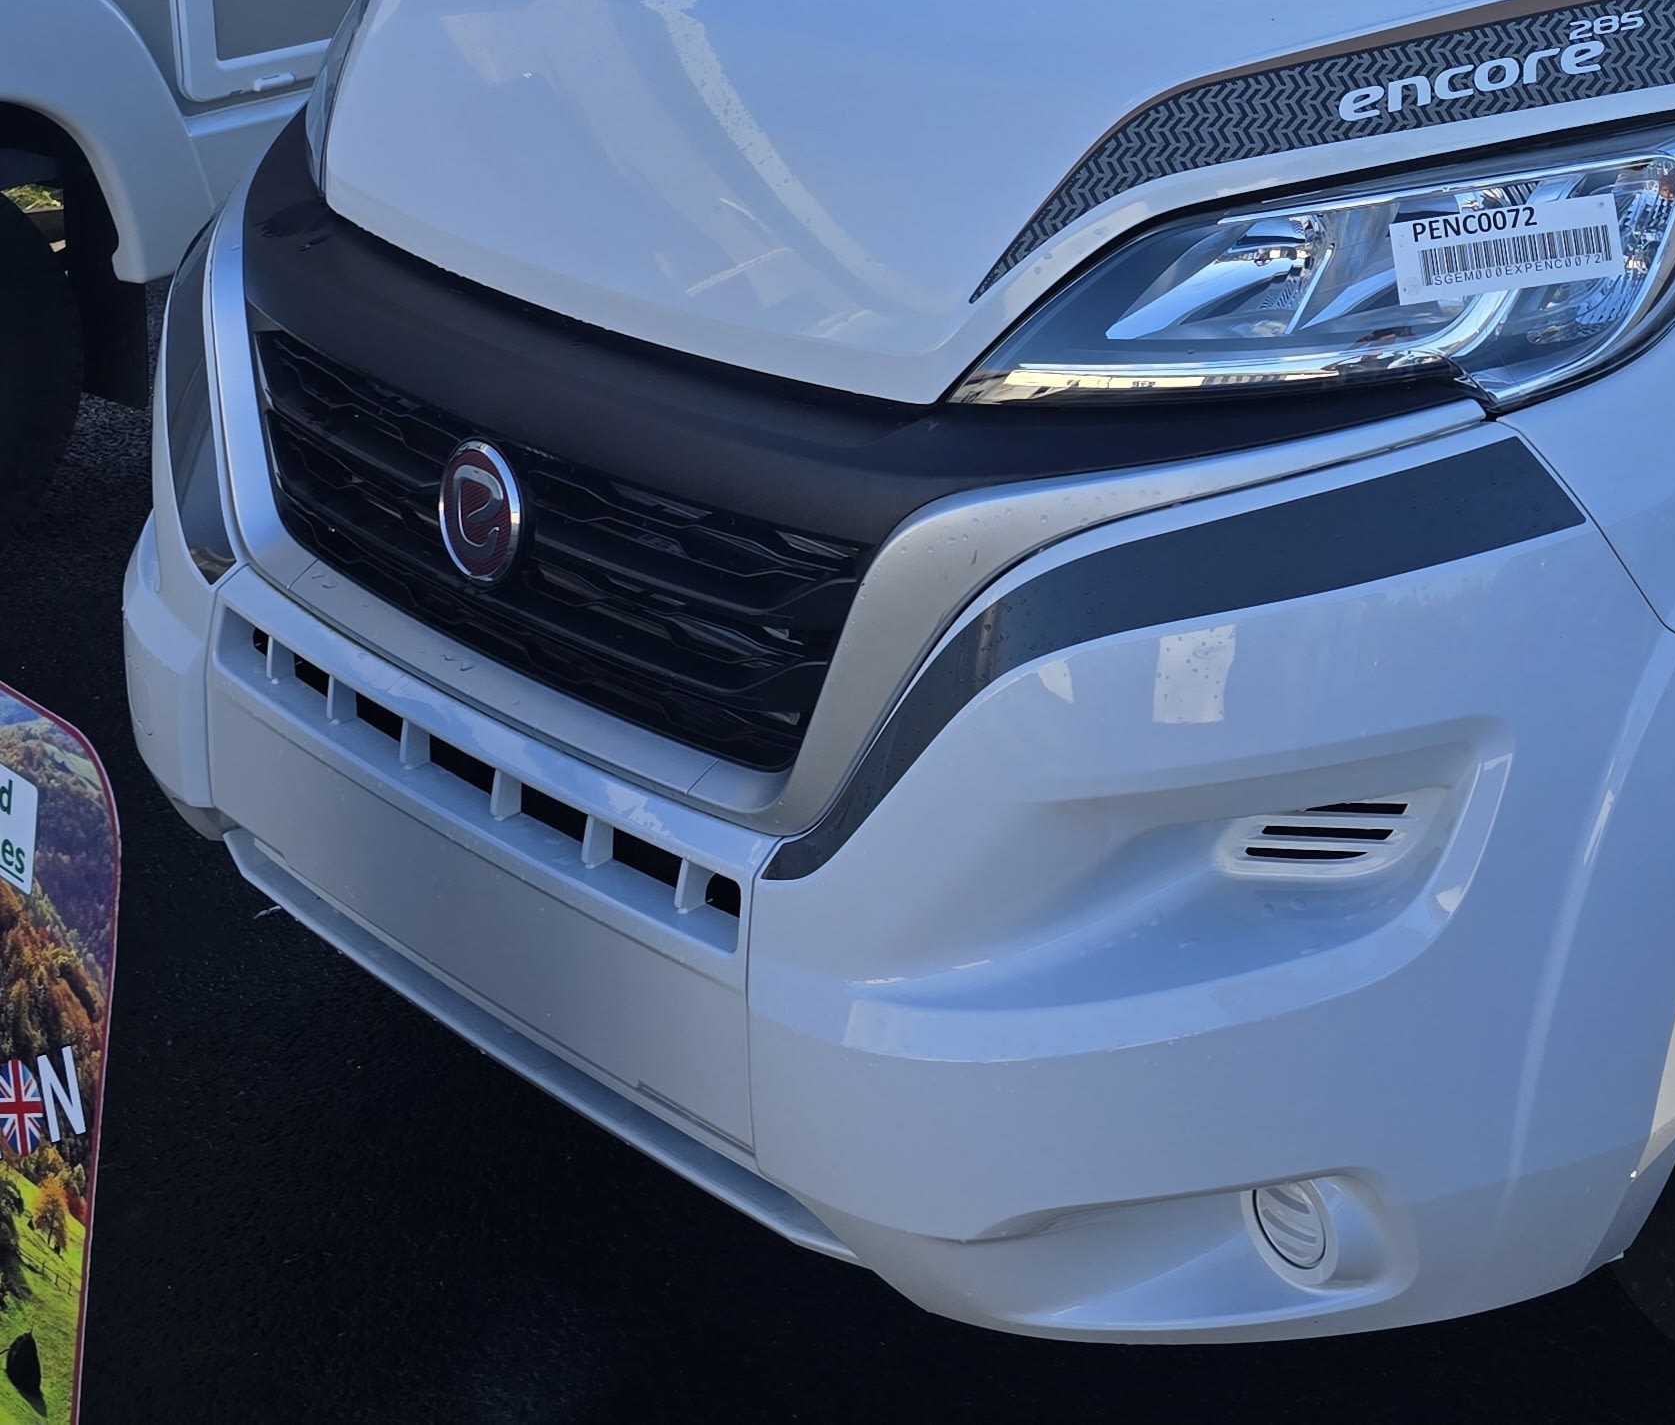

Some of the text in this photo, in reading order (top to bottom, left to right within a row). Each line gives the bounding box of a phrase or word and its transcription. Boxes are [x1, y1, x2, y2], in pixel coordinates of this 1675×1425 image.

[1338, 9, 1644, 122] encore 285
[1412, 205, 1538, 243] PENC0072
[1434, 253, 1602, 286] SGEM000EXPENC0072
